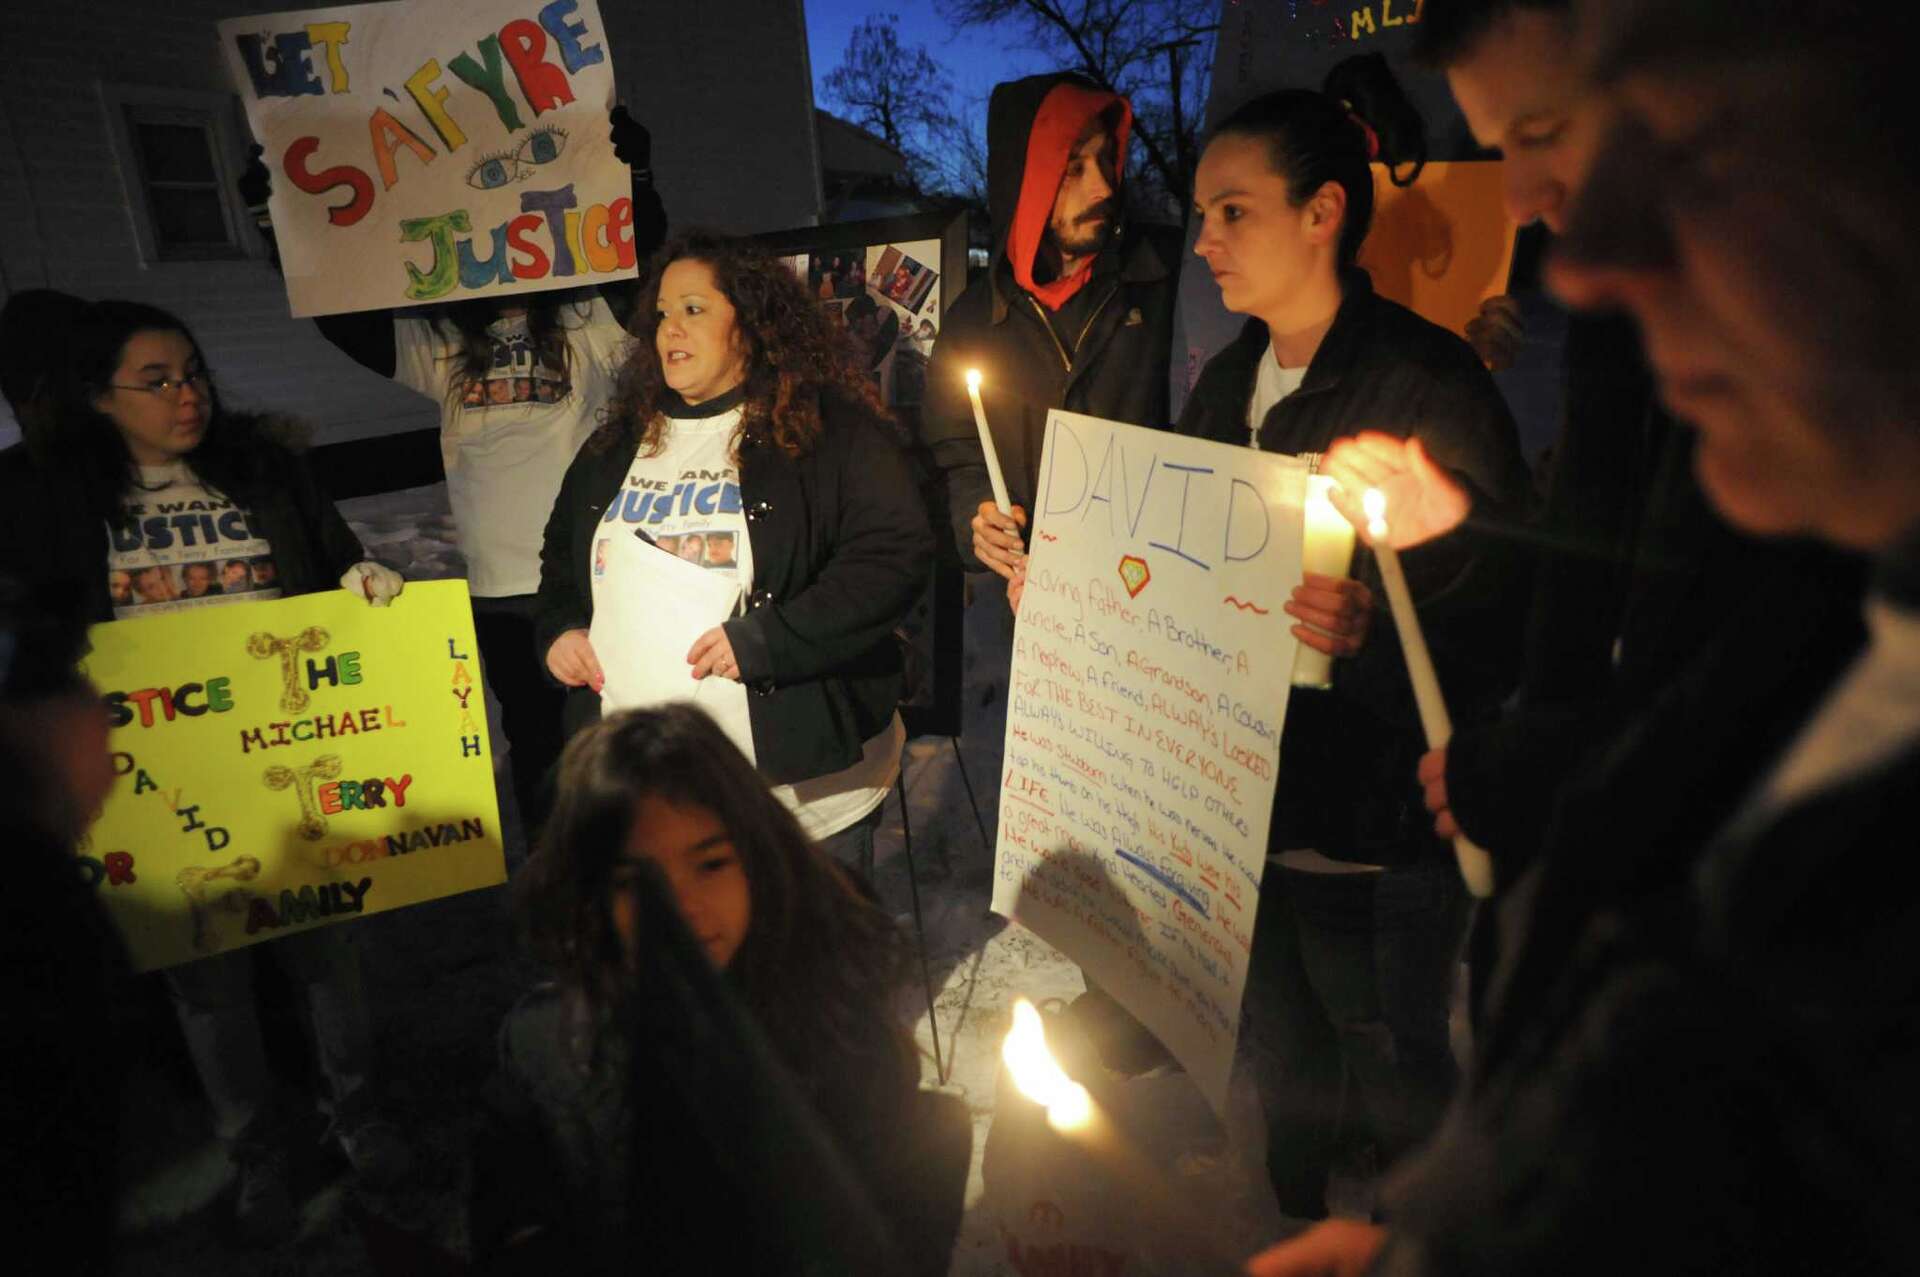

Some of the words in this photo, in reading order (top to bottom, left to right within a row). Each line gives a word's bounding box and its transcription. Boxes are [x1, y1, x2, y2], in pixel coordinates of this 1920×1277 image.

[629, 475, 668, 491] WE
[1043, 419, 1270, 571] DAVID
[246, 625, 362, 714] THE
[1237, 650, 1248, 674] A
[104, 677, 234, 728] STICE
[240, 705, 406, 754] MICHAEL
[448, 638, 481, 758] LAYAH
[1078, 690, 1119, 724] BEST
[1153, 729, 1243, 806] EVERYONE
[112, 752, 230, 850] DAVID
[263, 754, 412, 841] TERRY
[1162, 766, 1200, 801] HELP
[324, 817, 484, 868] DONNAVAN
